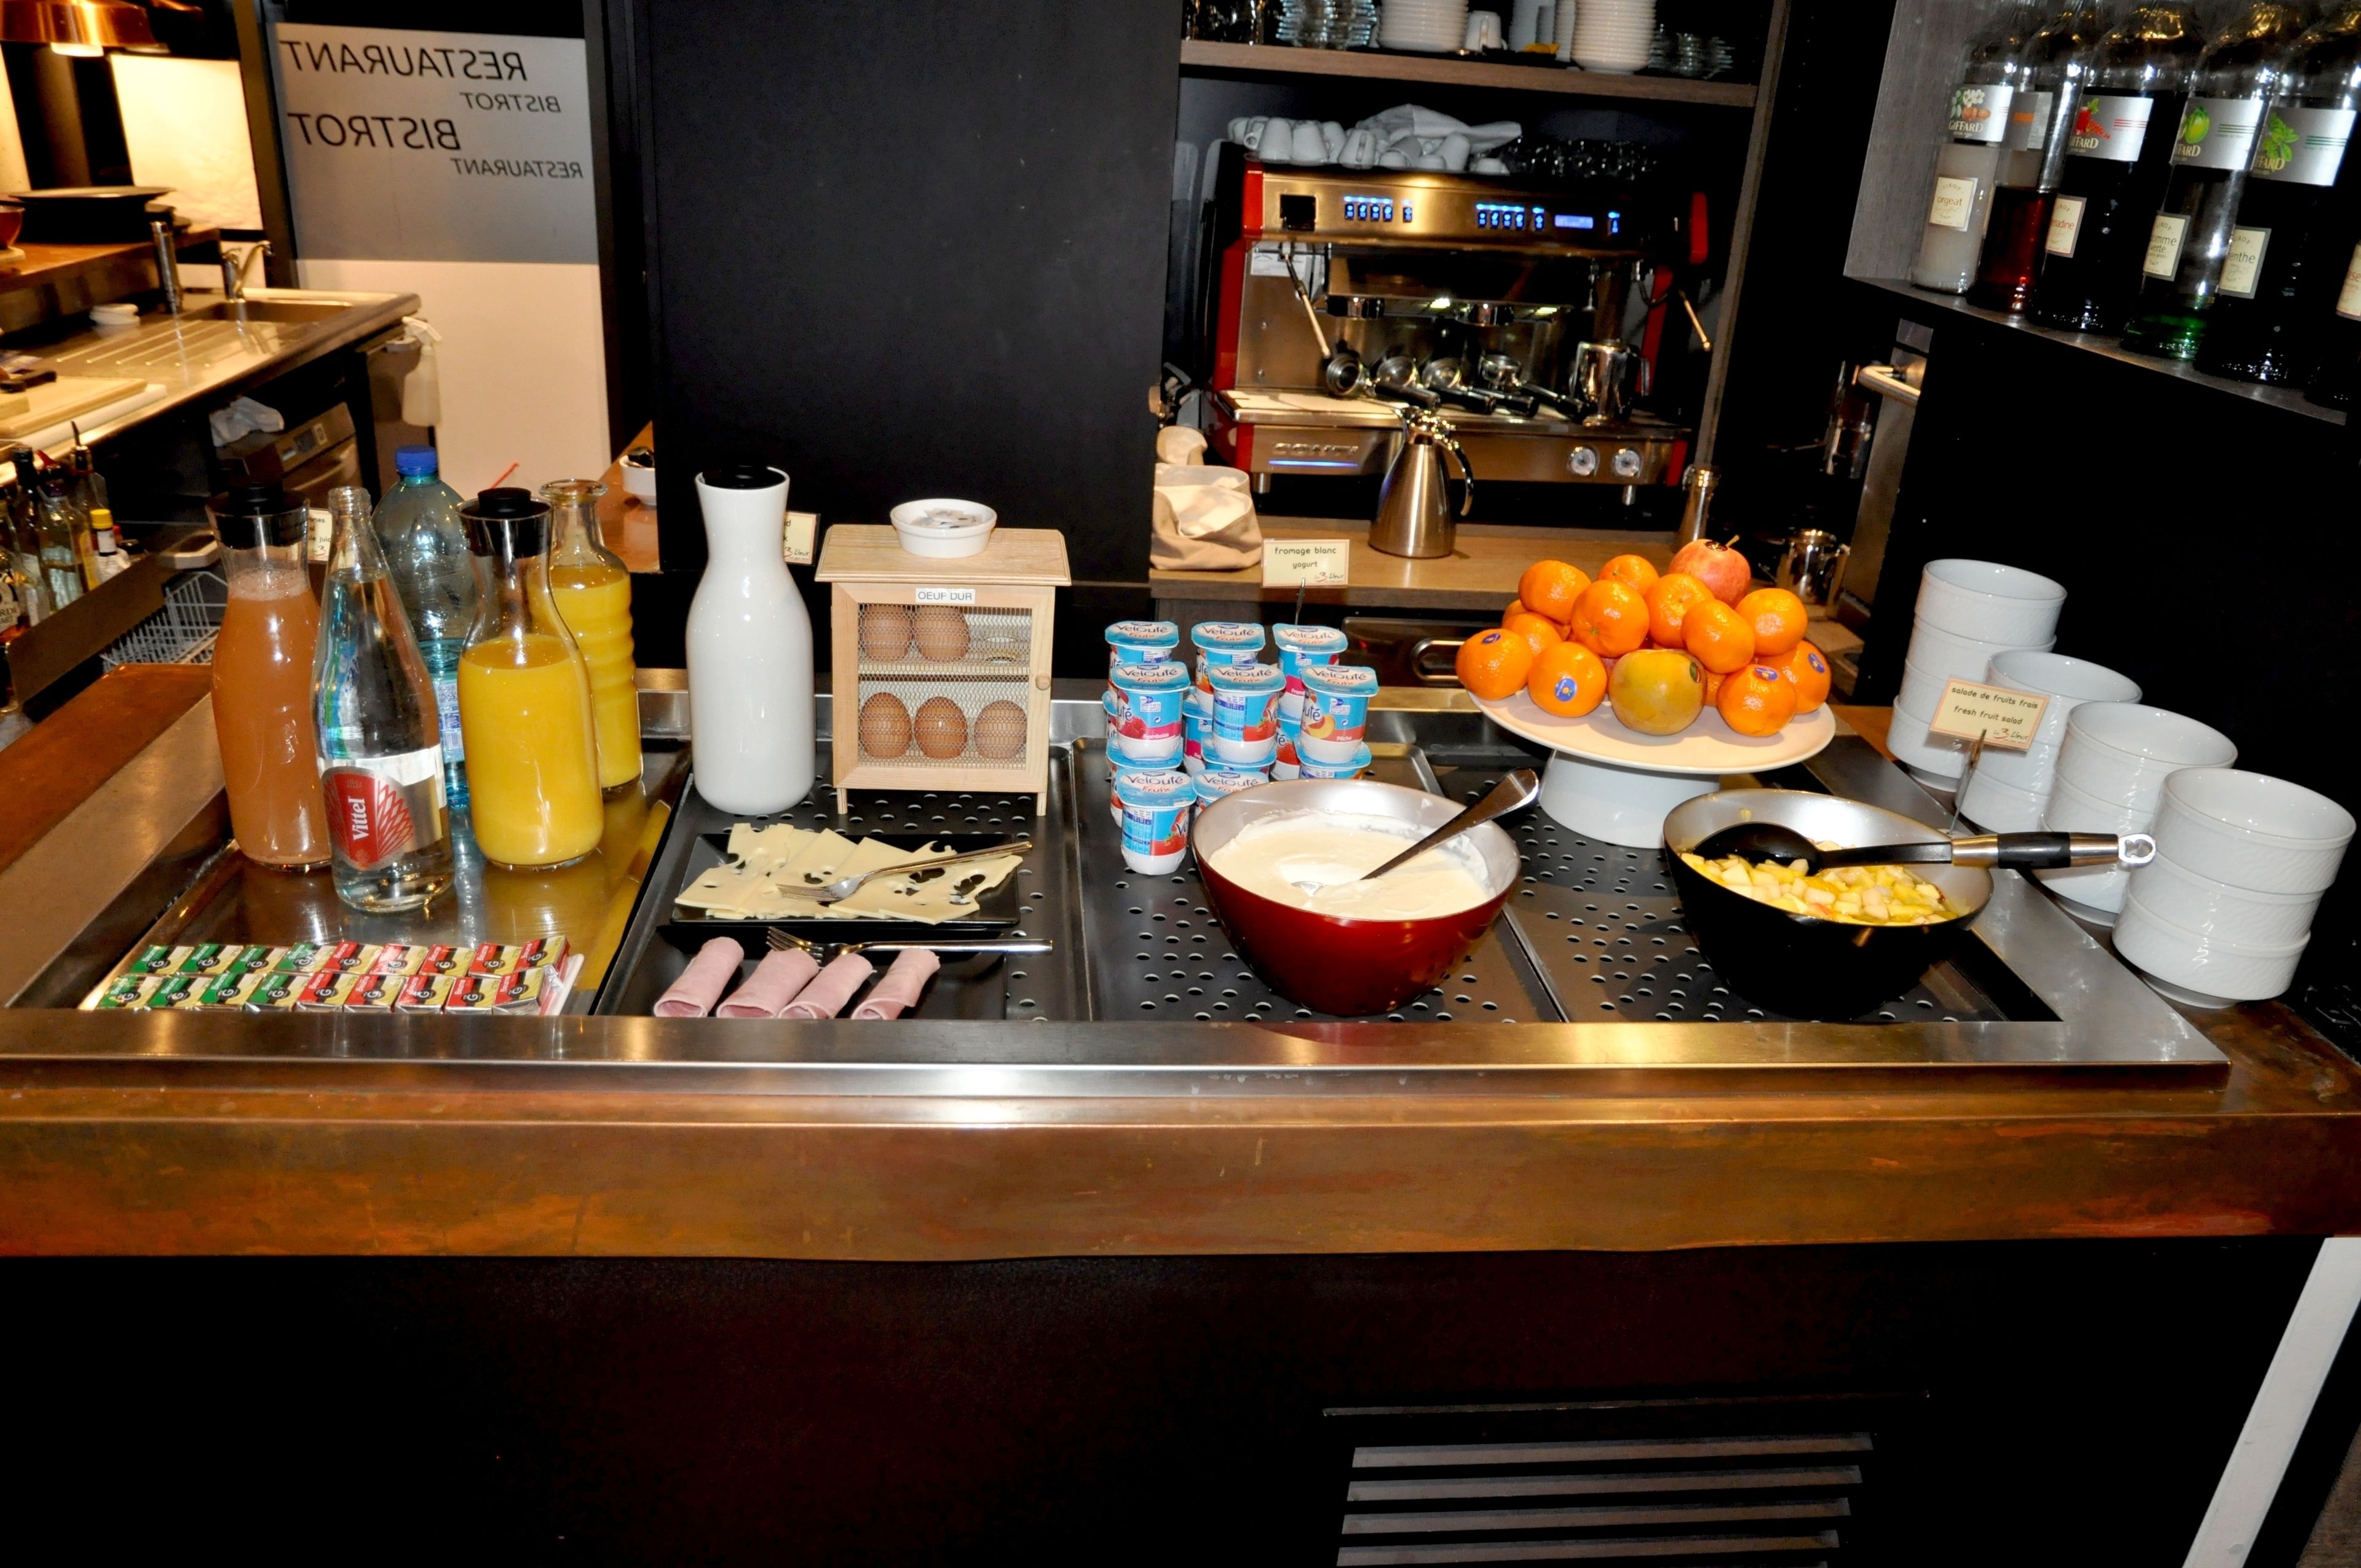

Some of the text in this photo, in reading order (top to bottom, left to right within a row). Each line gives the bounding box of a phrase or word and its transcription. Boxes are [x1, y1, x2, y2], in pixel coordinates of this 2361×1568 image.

[1948, 121, 1983, 132] GIFFARD
[1937, 197, 1962, 207] orgeat
[2229, 251, 2256, 264] enthe
[1275, 547, 1310, 556] fromage
[918, 591, 947, 600] OEUF
[1202, 626, 1254, 636] Velouté
[1283, 630, 1335, 639] Velouté
[1120, 668, 1177, 677] Velouté
[1216, 668, 1273, 676] Velouté
[1311, 667, 1367, 680] Velouté
[1952, 687, 1977, 697] salade
[1993, 694, 2016, 705] fruits
[2019, 699, 2038, 709] frais
[1953, 705, 2023, 725] fresh fruit salad
[1125, 775, 1184, 785] Velouté
[1201, 774, 1259, 786] Velouté
[348, 796, 369, 841] Vittel
[333, 943, 349, 959] Beurre
[309, 973, 325, 989] Beurre
[454, 979, 467, 995] Beurre
[500, 975, 511, 992] Beurre
